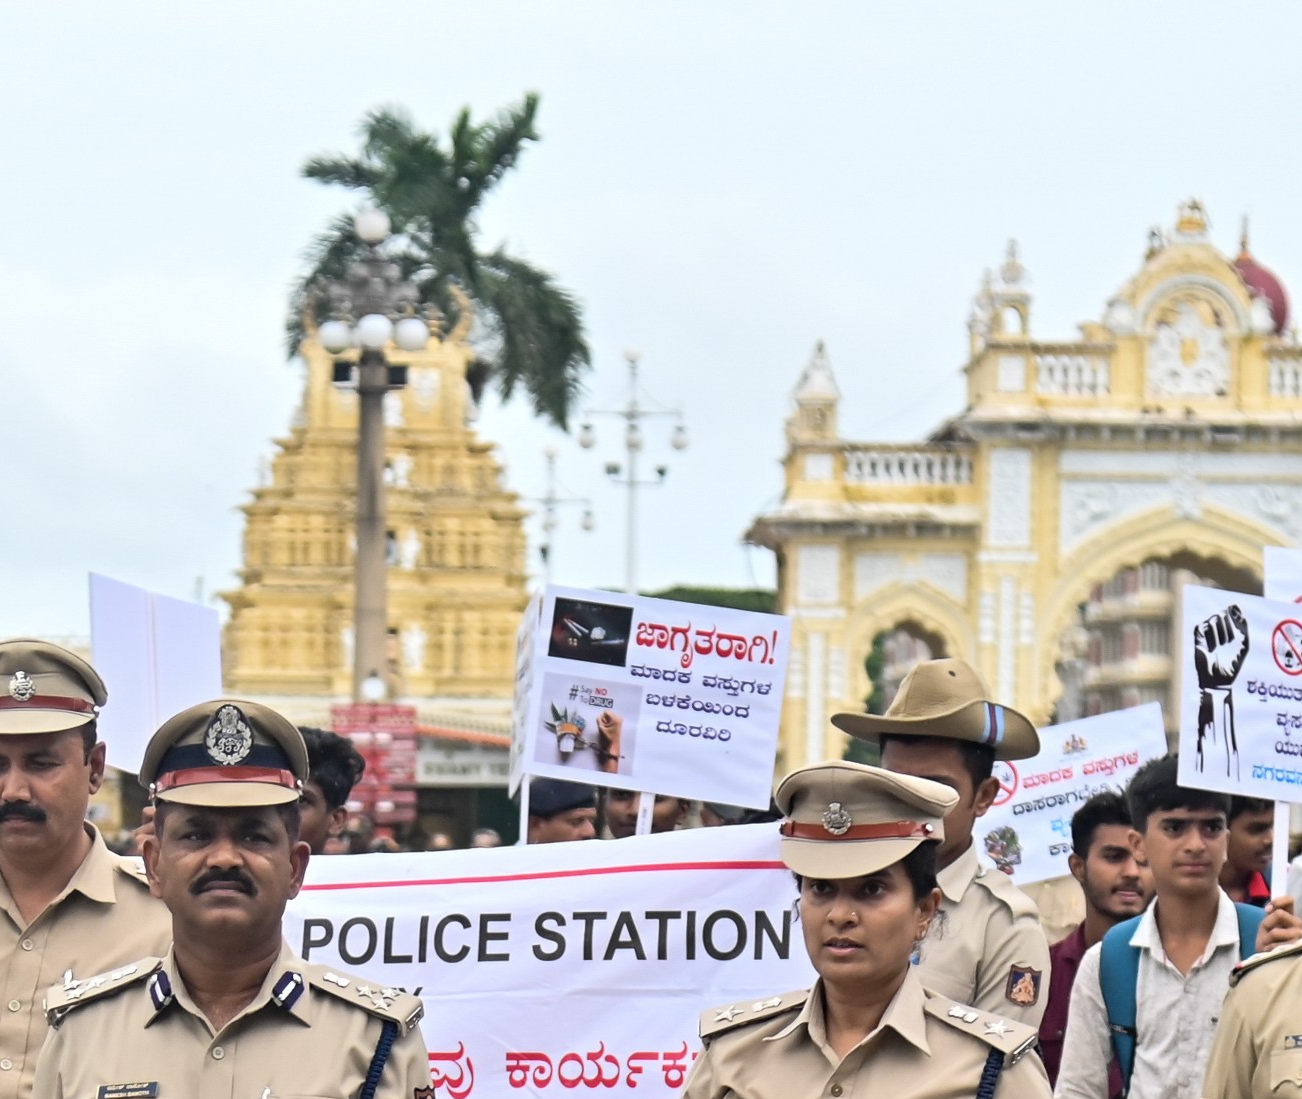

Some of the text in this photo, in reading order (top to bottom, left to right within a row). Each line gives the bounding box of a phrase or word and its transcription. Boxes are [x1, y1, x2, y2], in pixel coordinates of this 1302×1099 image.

[636, 621, 778, 669] ಜಾಗೃತರಾಗಿ!
[595, 688, 608, 696] NO
[630, 664, 772, 696] ಮಾದಕ ವಸ್ತುಗಳ
[589, 696, 614, 708] DRUG
[646, 691, 750, 718] ಬಳಕೆಯಿಂದ
[656, 719, 732, 742] ದೂರವಿರಿ
[1022, 751, 1140, 789] ಮಾದಕ ವಸ್ತುಗಳ
[302, 909, 793, 965] POLICE STATION
